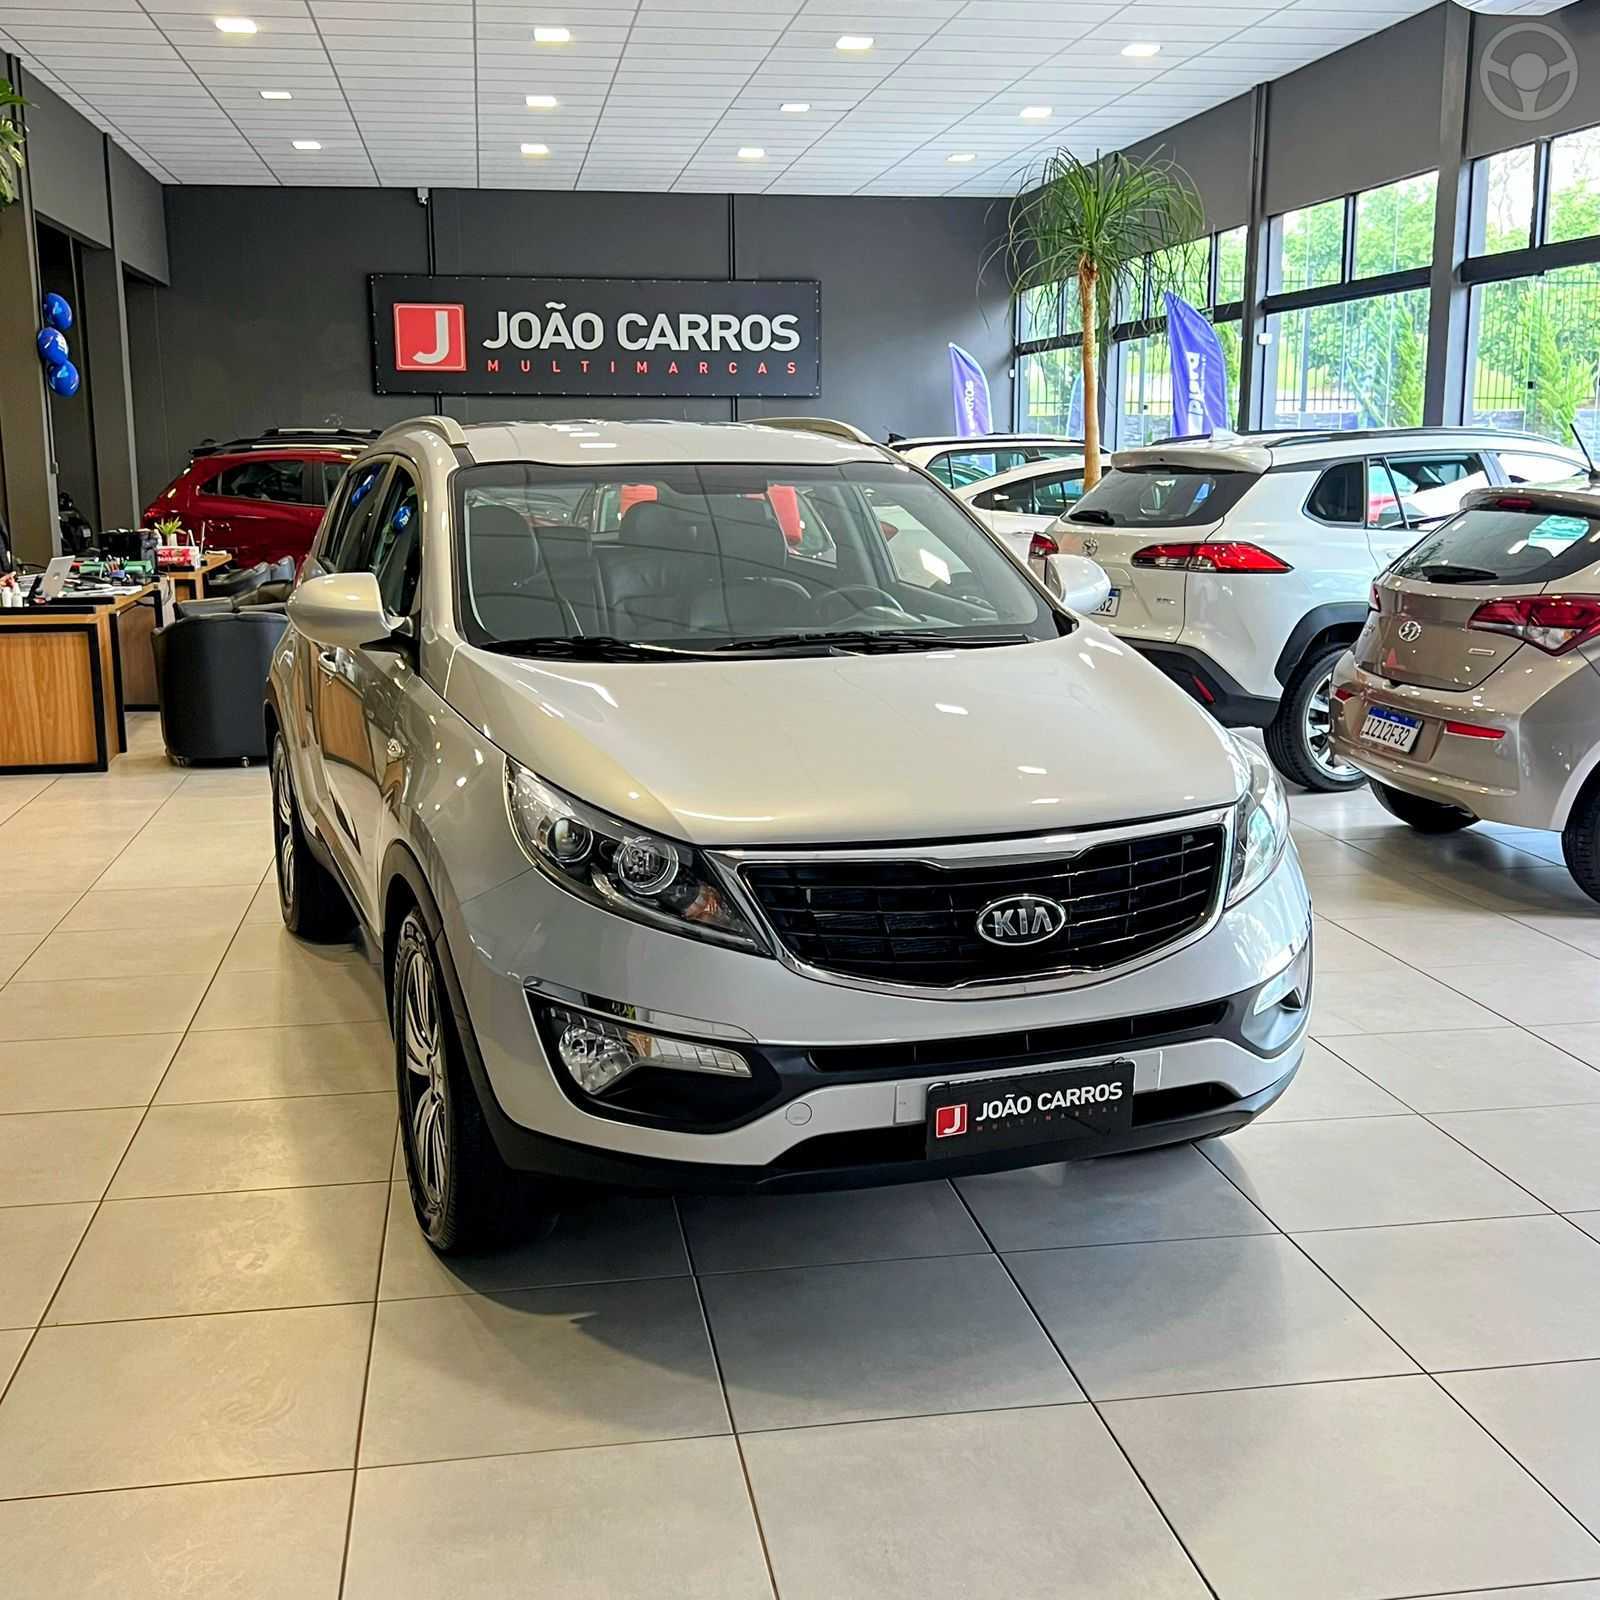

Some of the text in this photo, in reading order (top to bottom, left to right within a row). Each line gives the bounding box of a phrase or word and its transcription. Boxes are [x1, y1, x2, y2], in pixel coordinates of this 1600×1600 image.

[412, 310, 449, 365] J
[482, 301, 800, 351] JOÃO CARROS
[486, 358, 797, 374] MULTIMARCAS
[992, 906, 1053, 937] KIA
[975, 1081, 1123, 1121] JOÃO CARROS
[943, 1106, 961, 1134] J
